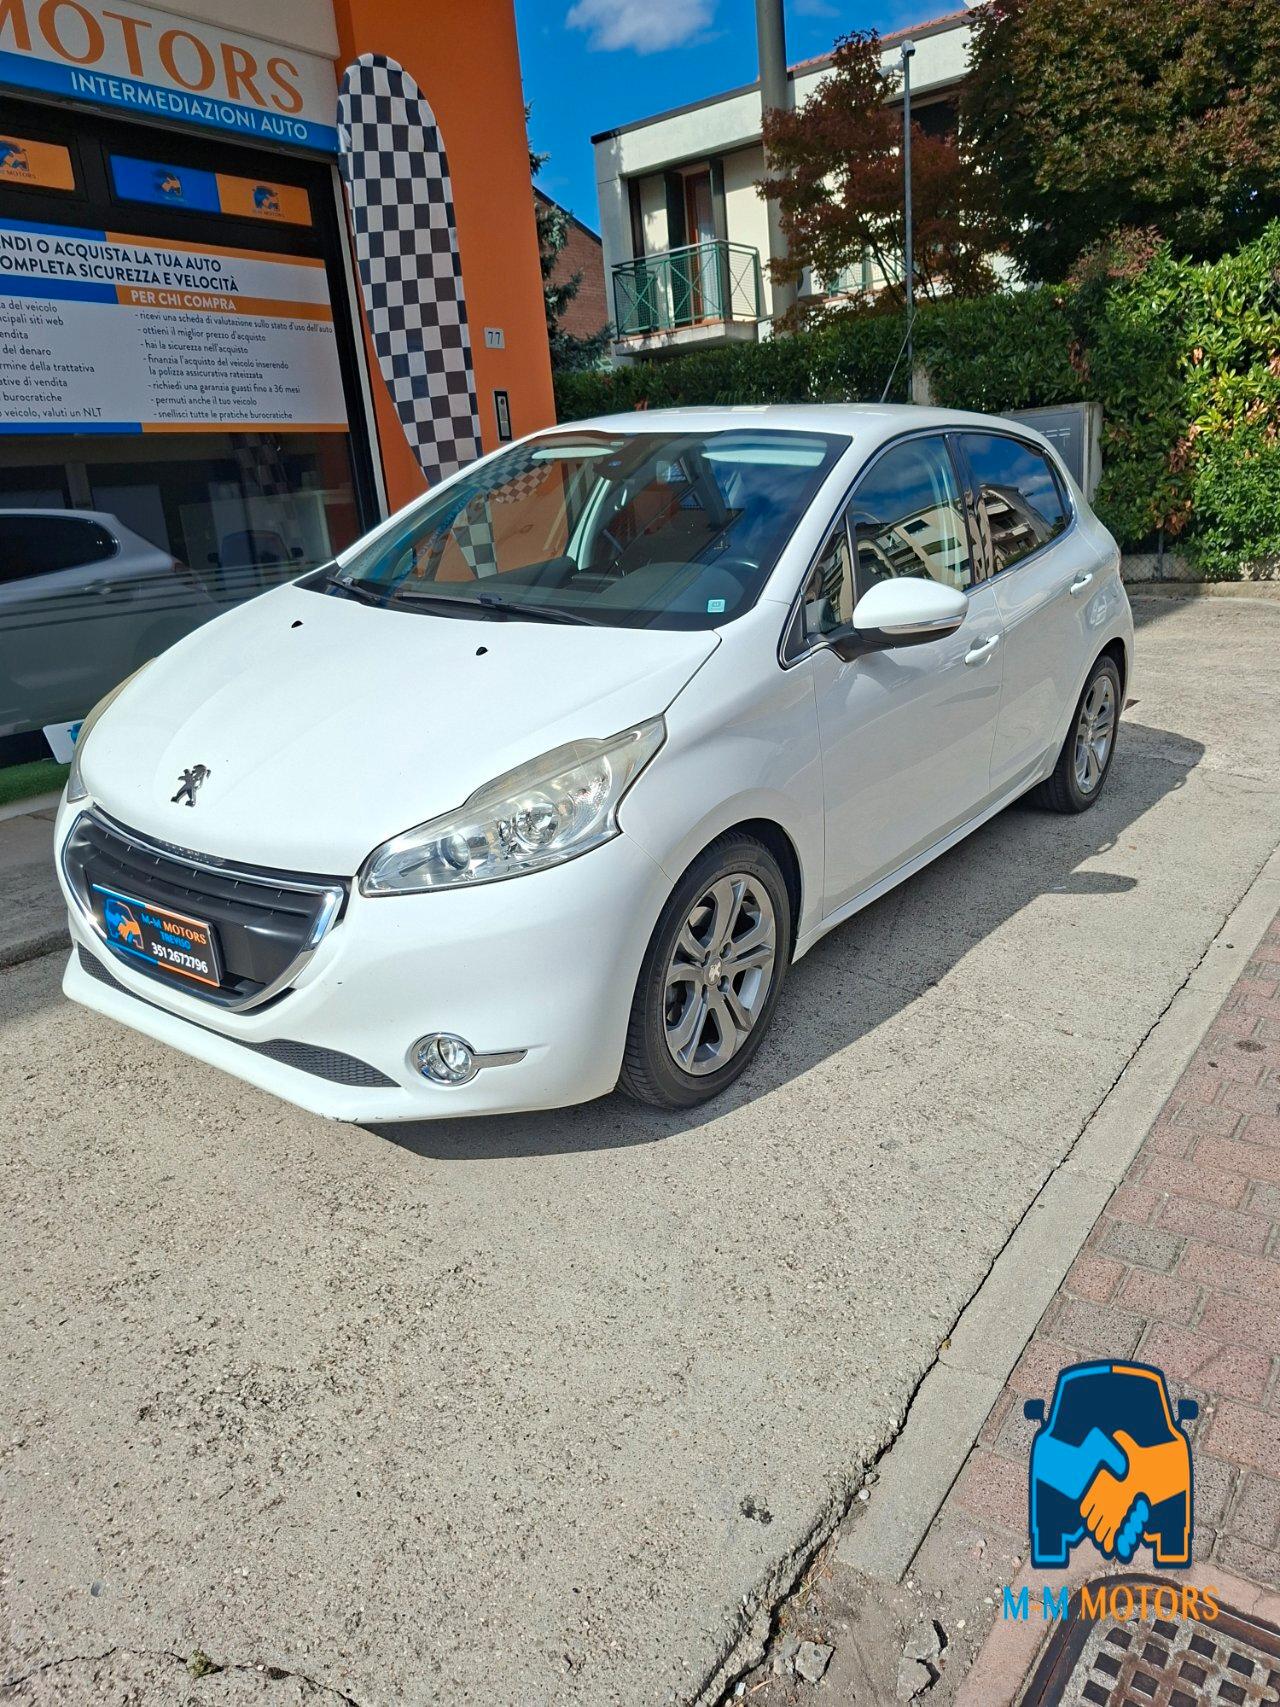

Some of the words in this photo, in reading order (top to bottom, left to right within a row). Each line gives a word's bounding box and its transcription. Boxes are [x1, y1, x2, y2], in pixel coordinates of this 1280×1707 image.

[71, 71, 256, 129] INTERMEDIAZIONI
[261, 116, 307, 140] AUTO
[0, 234, 33, 252] NDI
[37, 239, 49, 253] O
[55, 241, 131, 263] ACQUISTA
[134, 250, 153, 265] LA
[154, 253, 182, 269] TUA
[186, 257, 221, 272] AUTO
[79, 263, 160, 284] SICUREZZA
[163, 272, 172, 285] E
[174, 273, 239, 292] VELOCITÀ
[9, 299, 22, 310] del
[26, 301, 58, 313] veicolo
[130, 290, 156, 304] PER
[158, 293, 181, 307] CHI
[184, 295, 237, 311] COMPRA
[29, 314, 43, 325] siti
[45, 316, 64, 326] web
[140, 310, 161, 320] ricevi
[179, 314, 204, 324] scheda
[214, 317, 253, 327] valutazione
[143, 325, 169, 336] ottieni
[171, 326, 176, 336] il
[178, 328, 204, 341] miglior
[206, 332, 230, 341] prezzo
[488, 331, 501, 345] 77
[2, 344, 17, 354] del
[20, 345, 52, 356] denaro
[145, 339, 158, 349] hai
[160, 341, 167, 350] la
[168, 341, 202, 352] sicurezza
[30, 361, 51, 372] della
[54, 363, 95, 373] trattativa
[147, 353, 179, 365] finanzia
[217, 357, 229, 367] del
[230, 358, 255, 368] veicolo
[256, 359, 289, 370] inserendo
[149, 366, 157, 376] la
[158, 366, 185, 379] polizza
[185, 369, 229, 379] assicurativa
[23, 376, 32, 386] di
[34, 377, 68, 388] vendita
[153, 380, 182, 391] richiedi
[184, 384, 198, 392] una
[200, 383, 230, 395] garanzia
[231, 382, 252, 396] guasti
[253, 382, 267, 393] fino
[274, 384, 283, 393] 36
[285, 385, 301, 394] mesi
[3, 391, 63, 402] burocratiche
[155, 395, 187, 407] permuti
[188, 396, 211, 405] anche
[218, 398, 231, 406] tuo
[233, 397, 258, 406] veicolo
[43, 407, 67, 418] valuti
[83, 408, 102, 418] NLT
[158, 409, 188, 419] snellisci
[190, 410, 209, 419] tutte
[210, 409, 218, 419] le
[219, 409, 249, 421] pratiche
[250, 410, 293, 420] burocratiche
[163, 921, 207, 945] MOTORS
[151, 941, 167, 959] 351
[169, 950, 209, 974] 2672796
